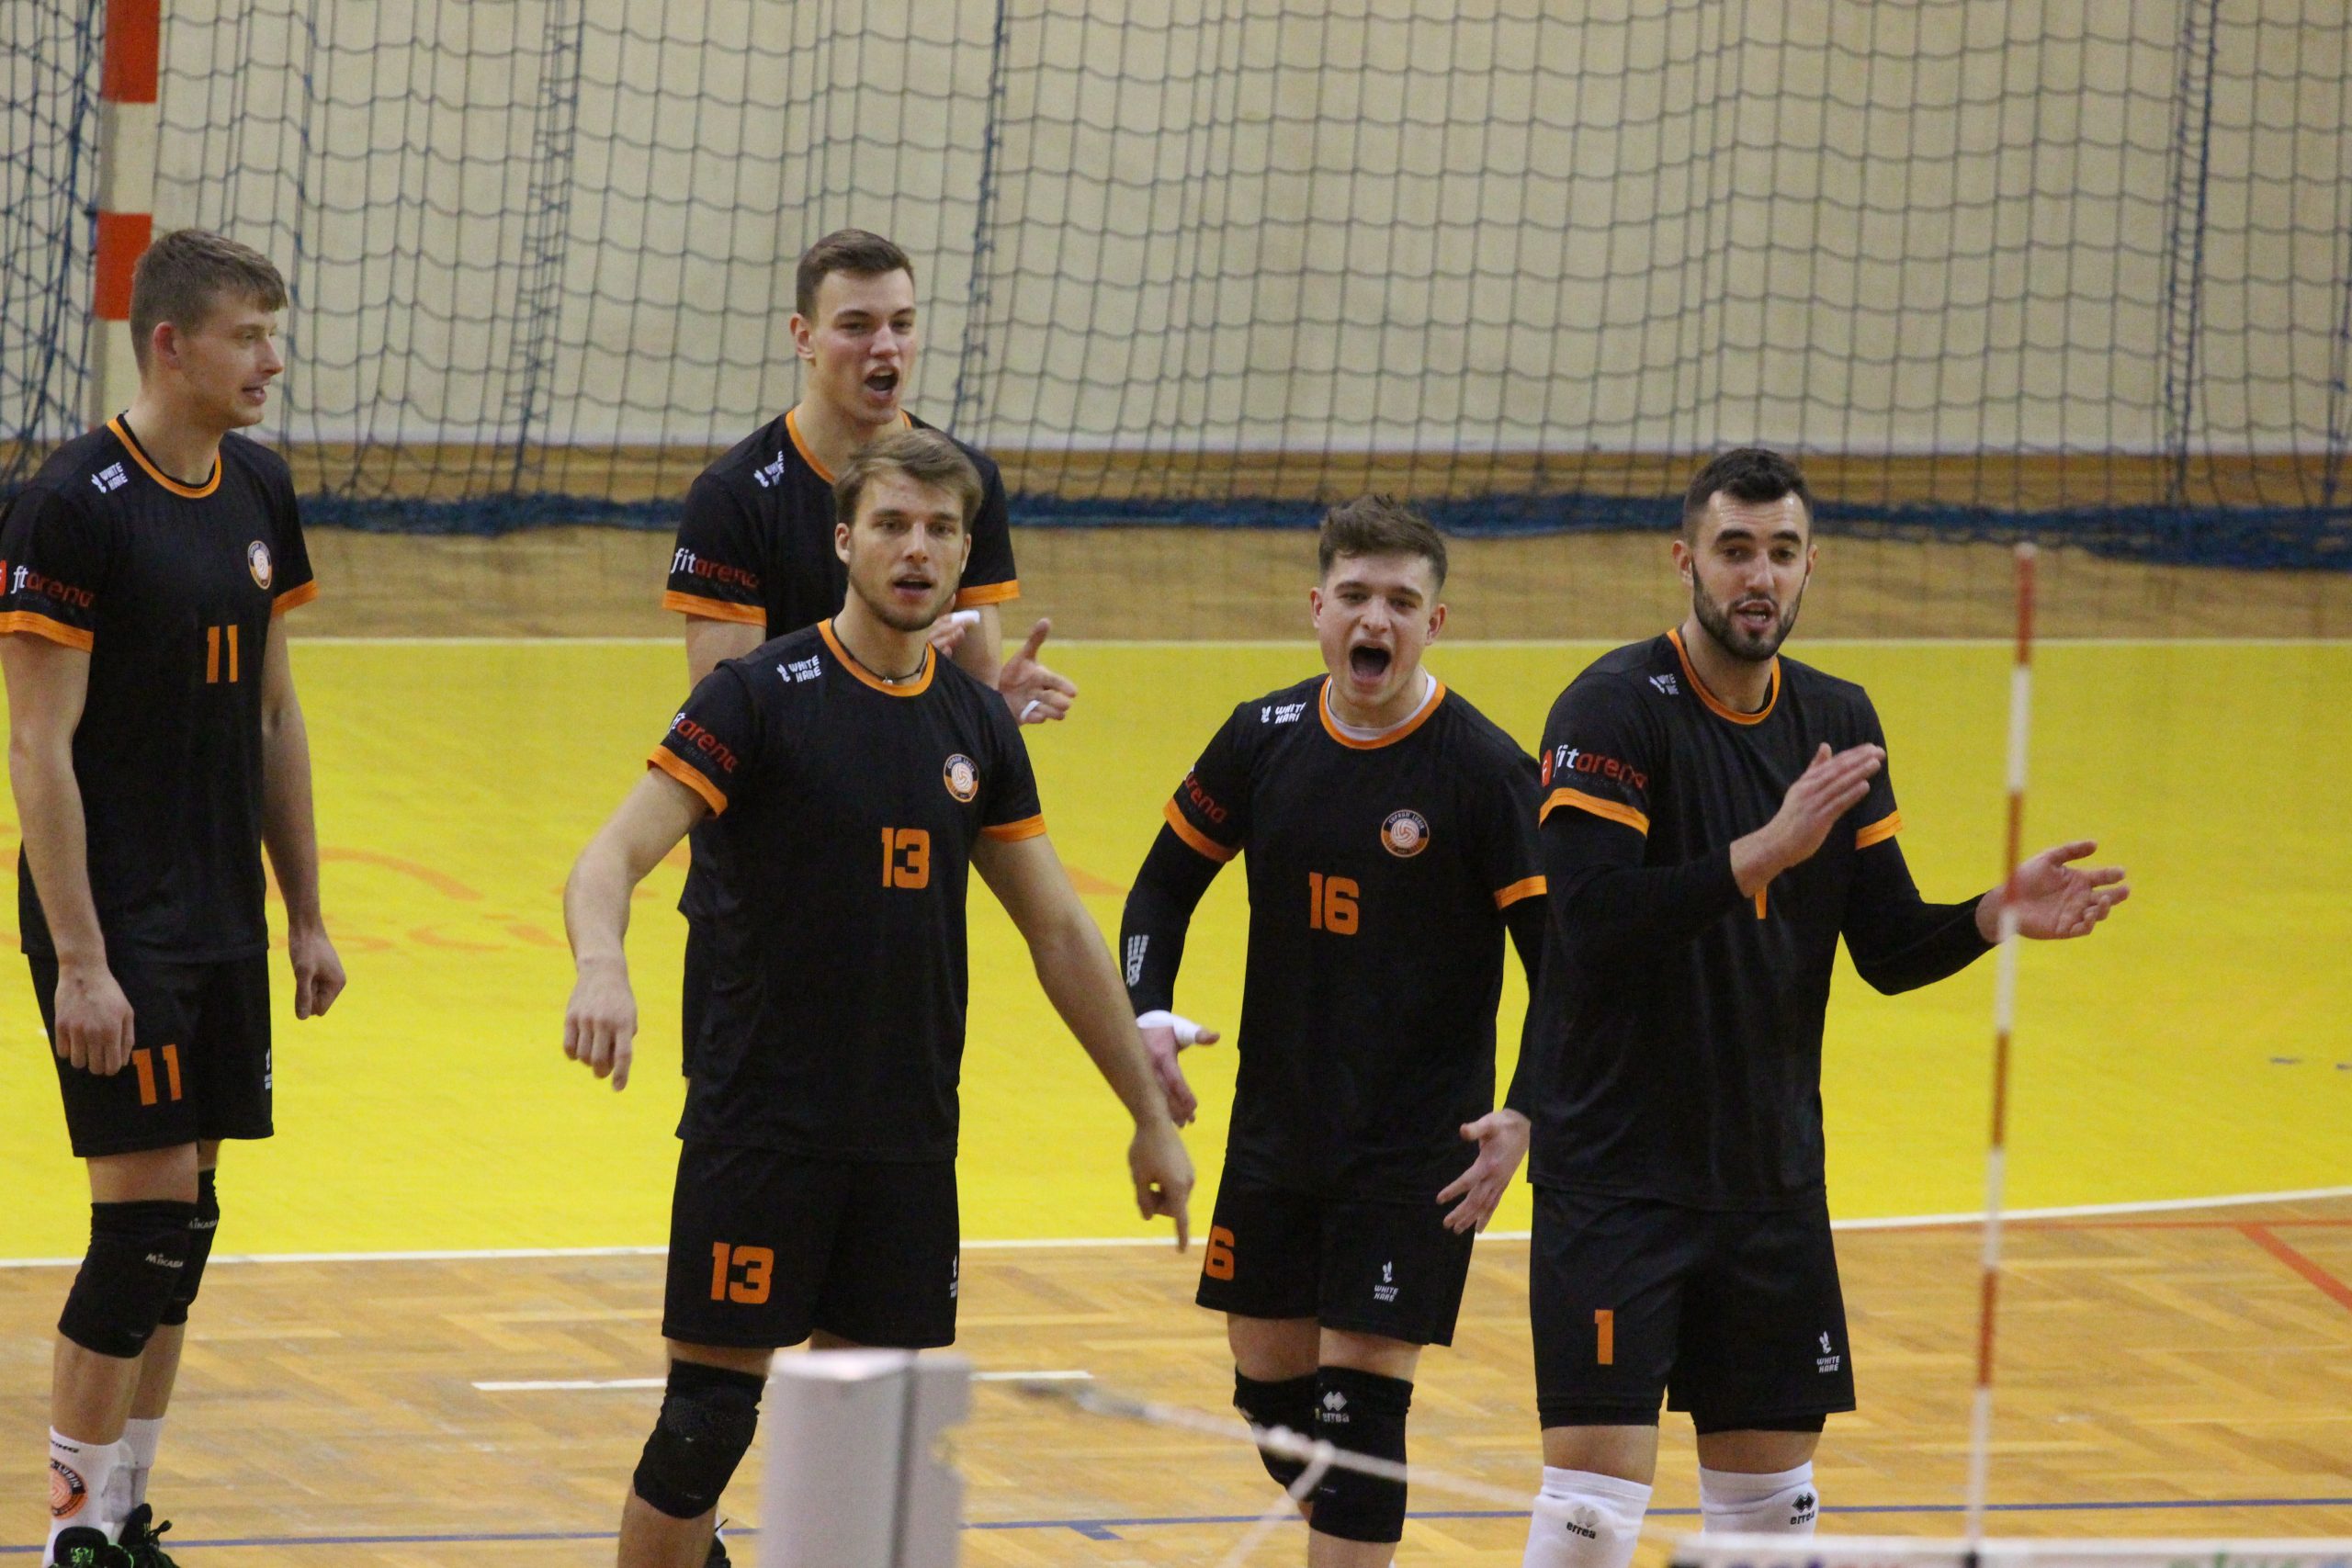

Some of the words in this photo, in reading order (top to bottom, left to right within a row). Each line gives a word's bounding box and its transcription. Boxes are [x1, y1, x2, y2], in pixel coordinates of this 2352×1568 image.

[207, 625, 238, 683] 11
[787, 655, 820, 672] WHITE
[795, 665, 822, 682] HARE
[1553, 744, 1648, 789] fitarena
[881, 827, 931, 889] 13
[1308, 872, 1360, 935] 16
[131, 1043, 183, 1107] 11
[710, 1241, 775, 1304] 13
[1374, 1284, 1399, 1296] WHITE
[1594, 1309, 1614, 1366] 1
[1816, 1355, 1840, 1366] WHITE
